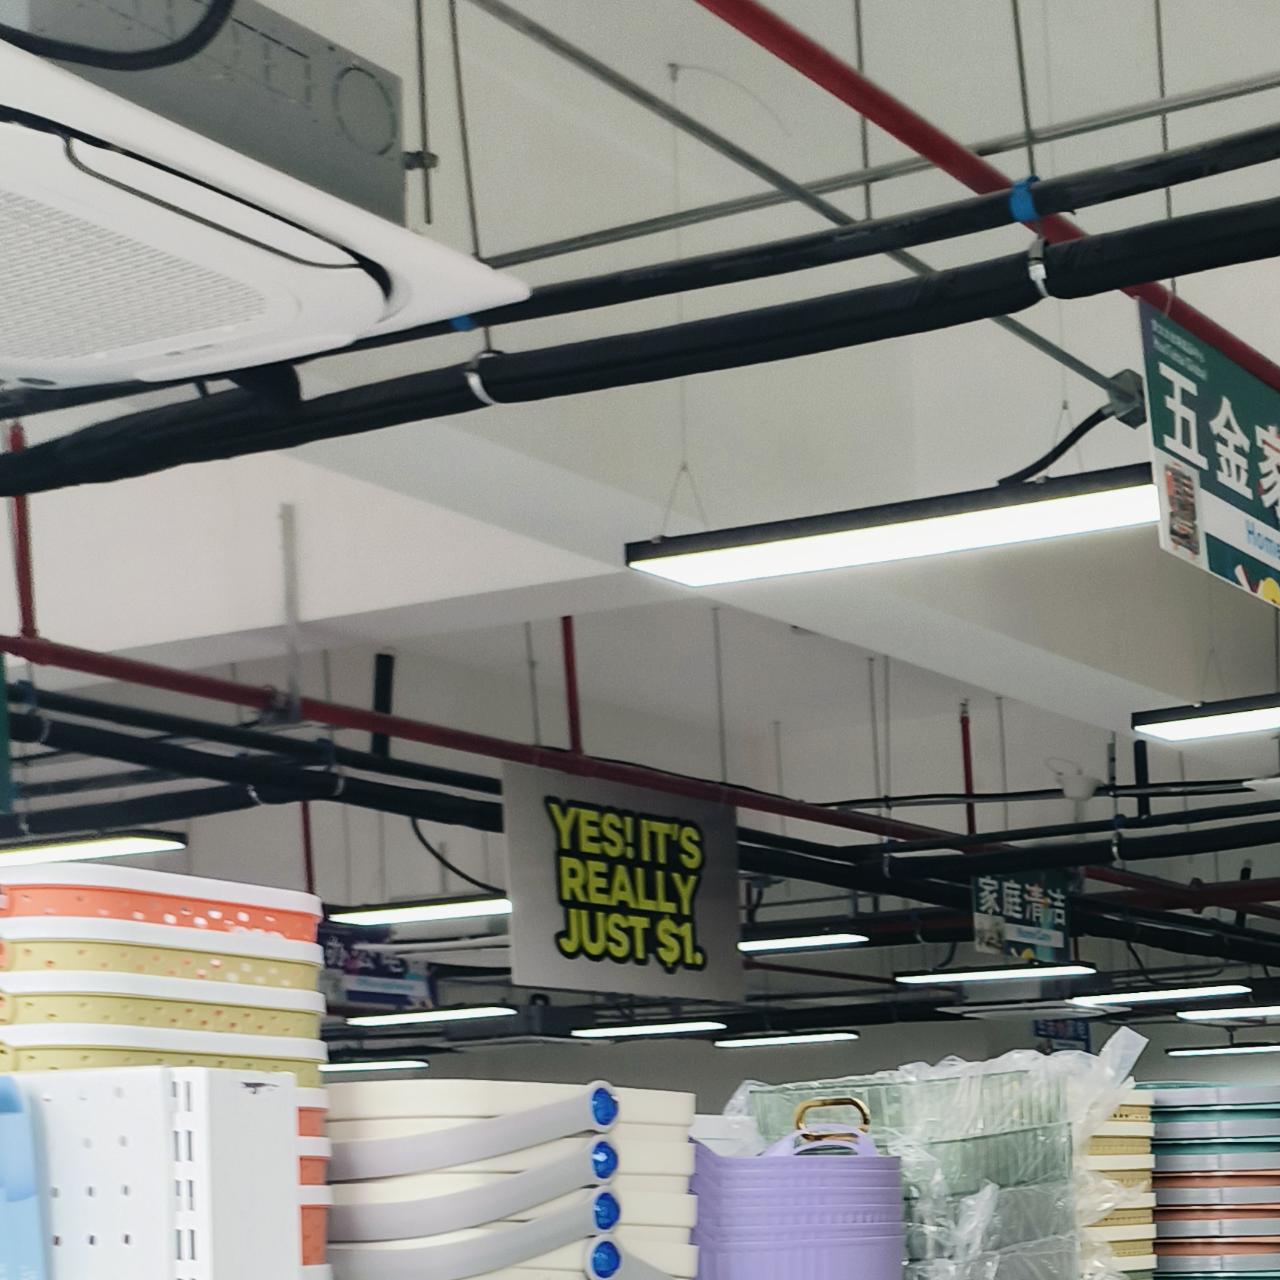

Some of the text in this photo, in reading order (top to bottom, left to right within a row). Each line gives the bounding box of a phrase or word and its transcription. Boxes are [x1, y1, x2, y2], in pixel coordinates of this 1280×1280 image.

[549, 801, 702, 870] YES! IT'S
[559, 855, 698, 916] REALLY
[558, 907, 704, 968] JUST $1.
